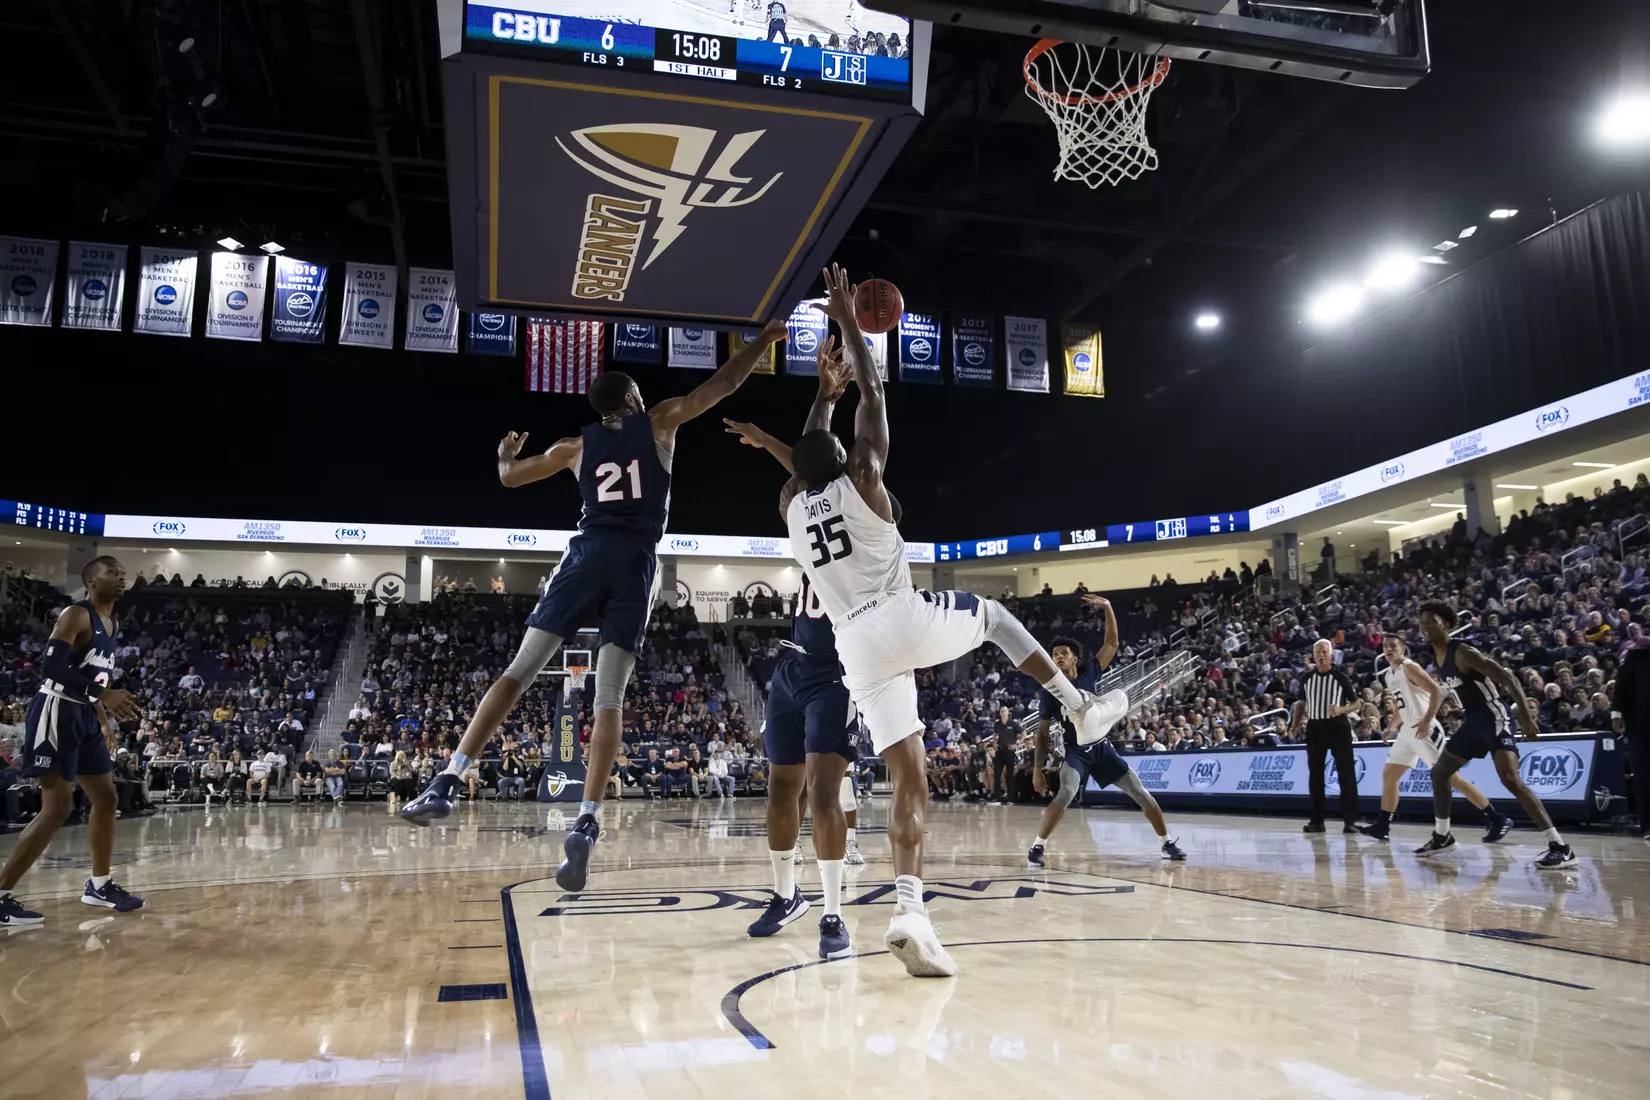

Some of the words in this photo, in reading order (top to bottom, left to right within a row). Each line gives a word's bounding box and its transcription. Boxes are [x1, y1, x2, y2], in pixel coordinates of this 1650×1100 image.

[492, 11, 561, 44] CBU
[601, 24, 614, 50] 6
[672, 32, 721, 61] 15:08
[583, 52, 607, 64] FLS
[616, 56, 624, 66] 3
[780, 46, 792, 72] 7
[668, 62, 690, 73] 1ST
[697, 66, 728, 78] HALF
[763, 74, 786, 87] FLS
[794, 78, 802, 89] 2
[10, 244, 45, 256] 2018
[571, 193, 652, 302] LANCERS
[80, 249, 114, 260] 2018
[153, 254, 184, 265] 2017
[153, 266, 180, 274] MEN'S
[225, 261, 255, 272] 2016
[287, 275, 314, 284] MEN'S
[356, 270, 386, 280] 2015
[419, 275, 449, 286] 2014
[357, 281, 382, 289] MEN'S
[156, 293, 176, 301] NCAA
[346, 288, 394, 298] BASKETBALL
[227, 299, 248, 307] NCAA
[145, 307, 177, 316] DIVISION
[217, 313, 248, 321] DIVISION
[137, 313, 189, 324] TOURNAMENT
[209, 318, 260, 329] TOURNAMENT
[907, 313, 932, 323] 2017
[961, 319, 985, 328] 2017
[346, 320, 381, 329] DIVISION
[904, 322, 936, 331] WOMEN'S
[1013, 323, 1037, 333] 2017
[348, 329, 375, 337] SWEET
[468, 332, 513, 341] CHAMPIONS
[616, 339, 660, 349] CHAMPIONS
[673, 350, 712, 358] CHAMPIONS
[785, 354, 817, 362] CHAMPIO
[901, 362, 940, 371] CHAMPIONS
[1541, 409, 1562, 425] FOX
[1385, 465, 1399, 477] FOX
[595, 460, 642, 502] 21
[16, 510, 27, 518] PTS
[17, 502, 31, 511] PLYR
[59, 509, 66, 517] 13
[69, 511, 76, 519] 21
[16, 517, 27, 525] FLS
[244, 522, 281, 531] AM1350
[159, 523, 179, 531] FOX
[341, 528, 360, 537] FOX
[420, 528, 457, 537] AM1350
[513, 534, 531, 542] FOX
[1070, 528, 1097, 543] 15:08
[1125, 525, 1134, 542] 7
[676, 539, 693, 547] FOX
[806, 514, 853, 569] 35
[1033, 535, 1042, 551] 6
[976, 539, 1009, 557] CBU
[847, 599, 878, 621] LanceUp
[559, 715, 574, 762] CBU
[1137, 758, 1172, 772] AM1350
[1248, 755, 1296, 771] AM1350
[1527, 755, 1571, 777] FOX
[1195, 763, 1216, 778] FOX
[1250, 770, 1285, 781] RIVERSIDE
[1192, 777, 1213, 785] SPORTS
[1236, 781, 1251, 791] SAN
[1251, 780, 1295, 791] BERNARDINO
[1526, 776, 1568, 786] SPORTS
